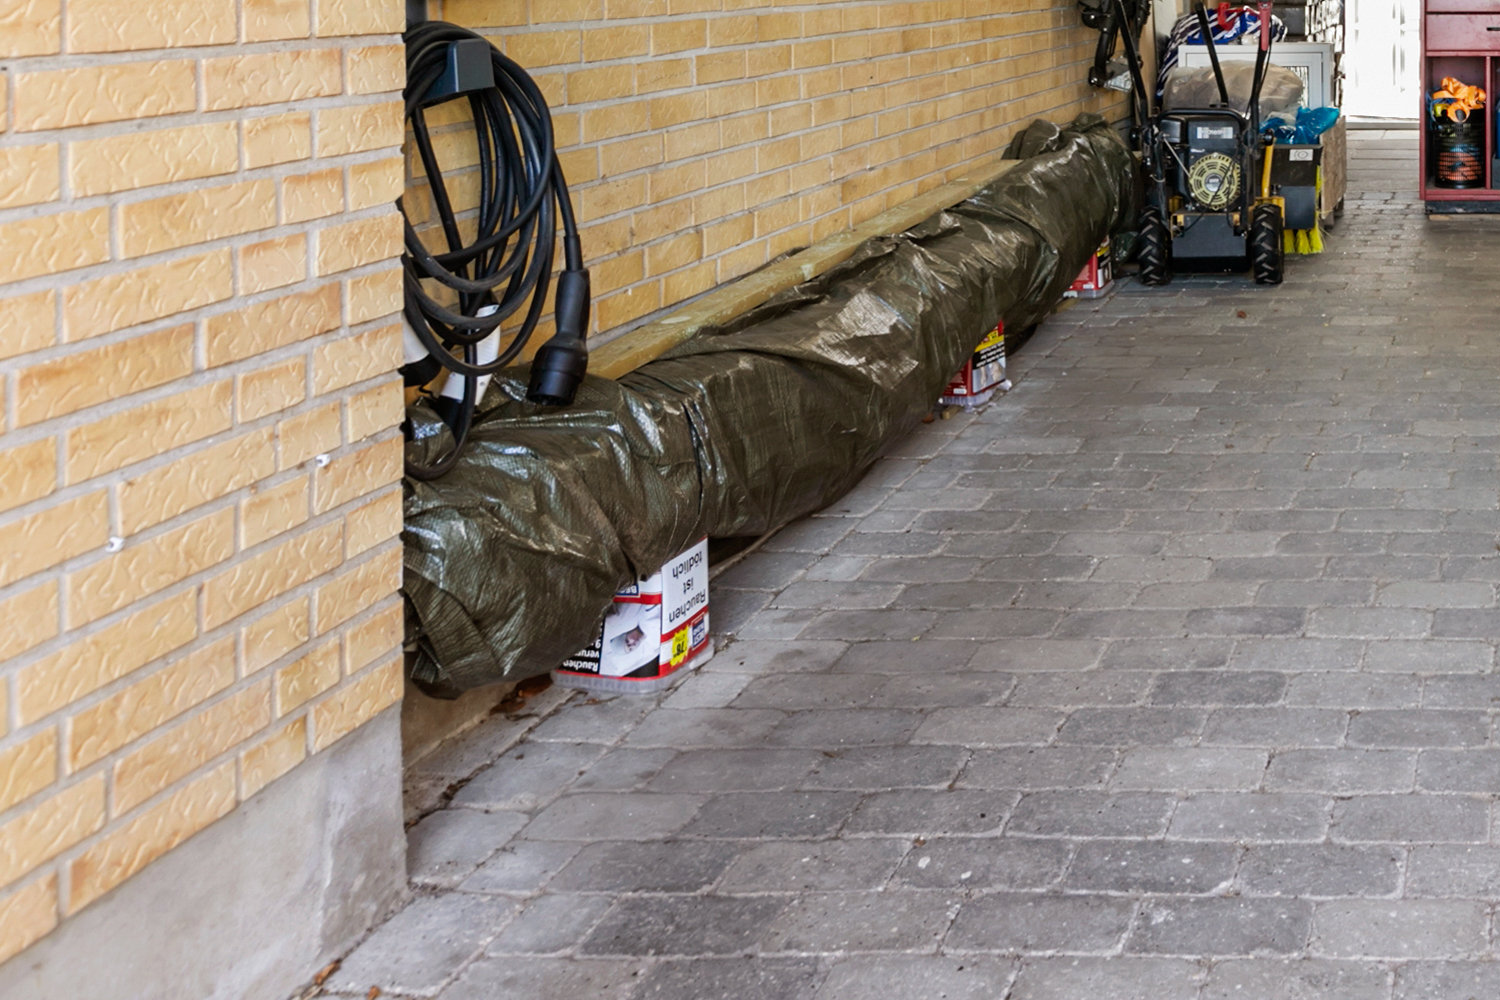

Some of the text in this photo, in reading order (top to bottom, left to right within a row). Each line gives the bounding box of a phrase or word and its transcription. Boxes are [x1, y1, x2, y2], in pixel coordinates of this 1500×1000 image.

[672, 550, 703, 579] tödlich
[683, 577, 694, 595] ist
[668, 590, 706, 623] Rauchen
